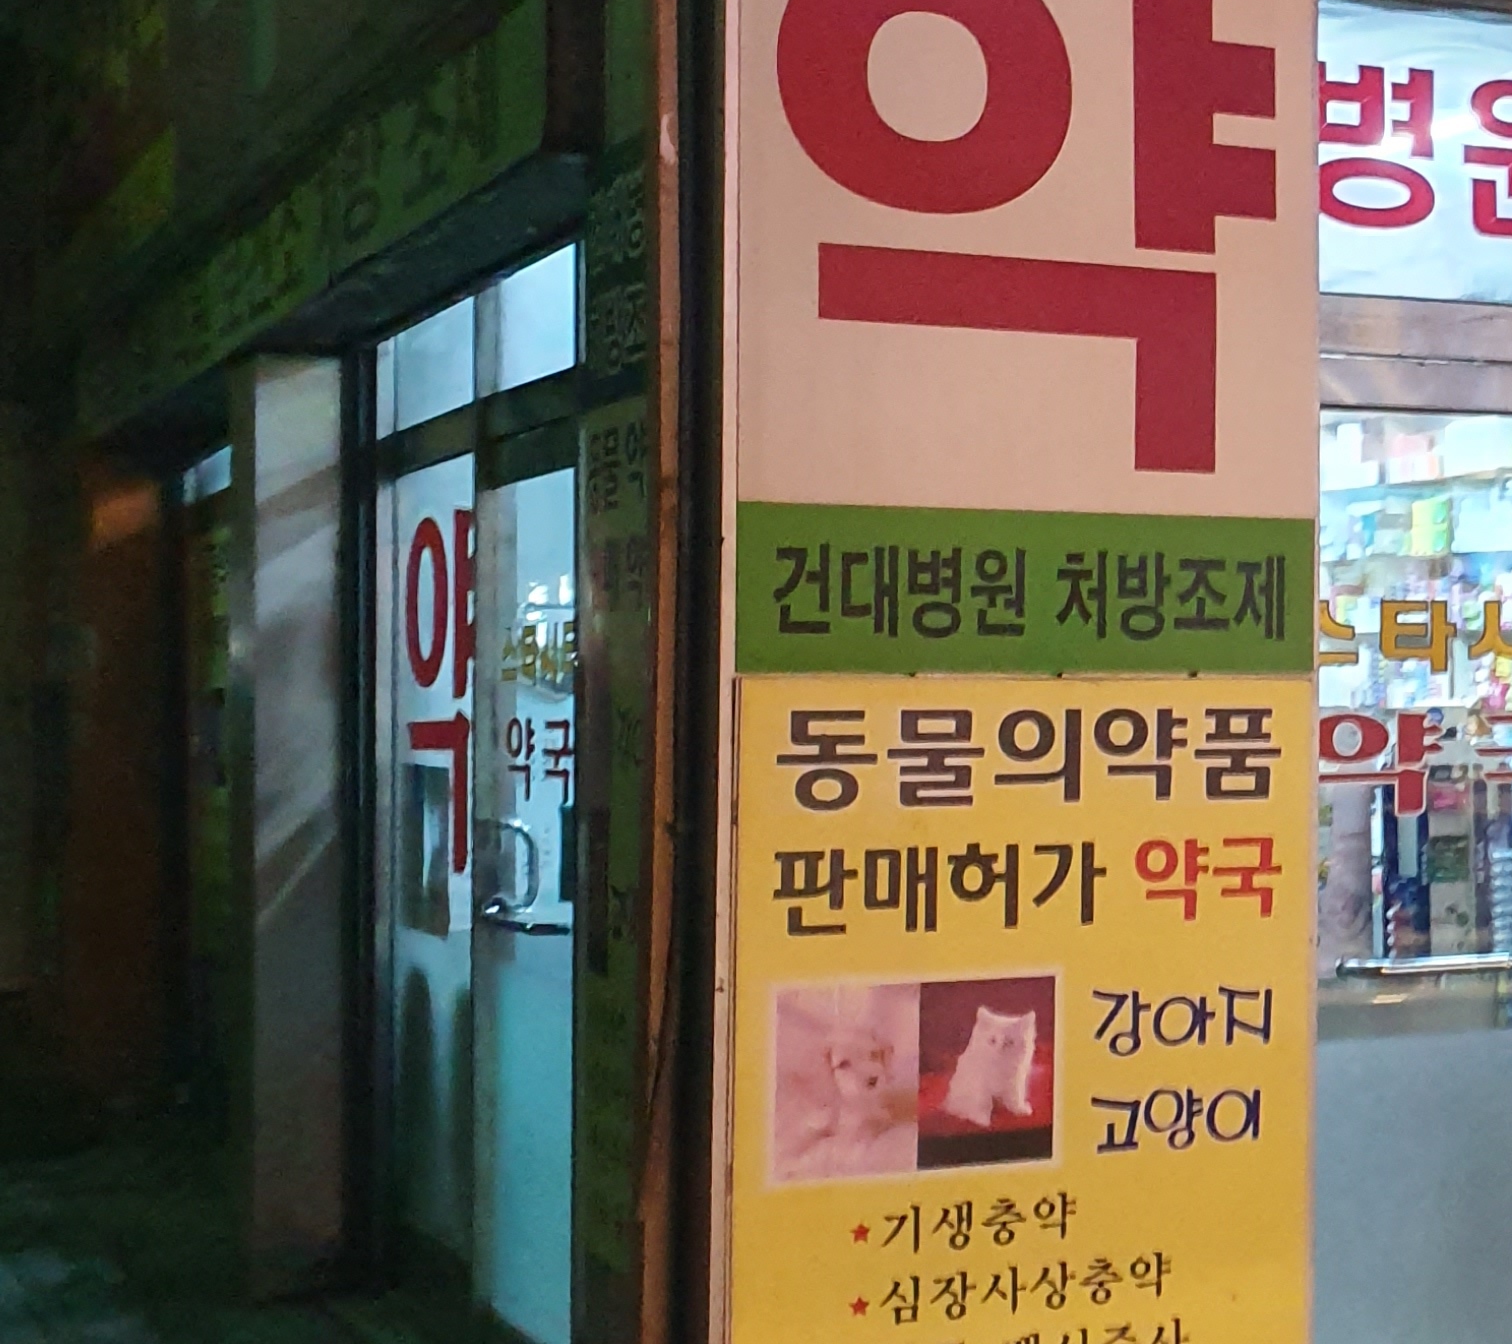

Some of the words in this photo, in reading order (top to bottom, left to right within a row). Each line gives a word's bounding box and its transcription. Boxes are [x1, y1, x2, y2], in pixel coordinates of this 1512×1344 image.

[774, 543, 1026, 640] 건대병원
[1055, 549, 1286, 641] 처방조제
[405, 508, 475, 873] 약
[506, 716, 574, 804] 약국
[776, 708, 1282, 810] 동물의약품
[773, 840, 1107, 936] 판매허가
[1135, 837, 1282, 921] 약국
[1092, 986, 1274, 1056] 강아지
[1091, 1088, 1263, 1154] 고양이
[881, 1192, 1077, 1253] 기생충약
[879, 1252, 1172, 1326] 심장사상충약
